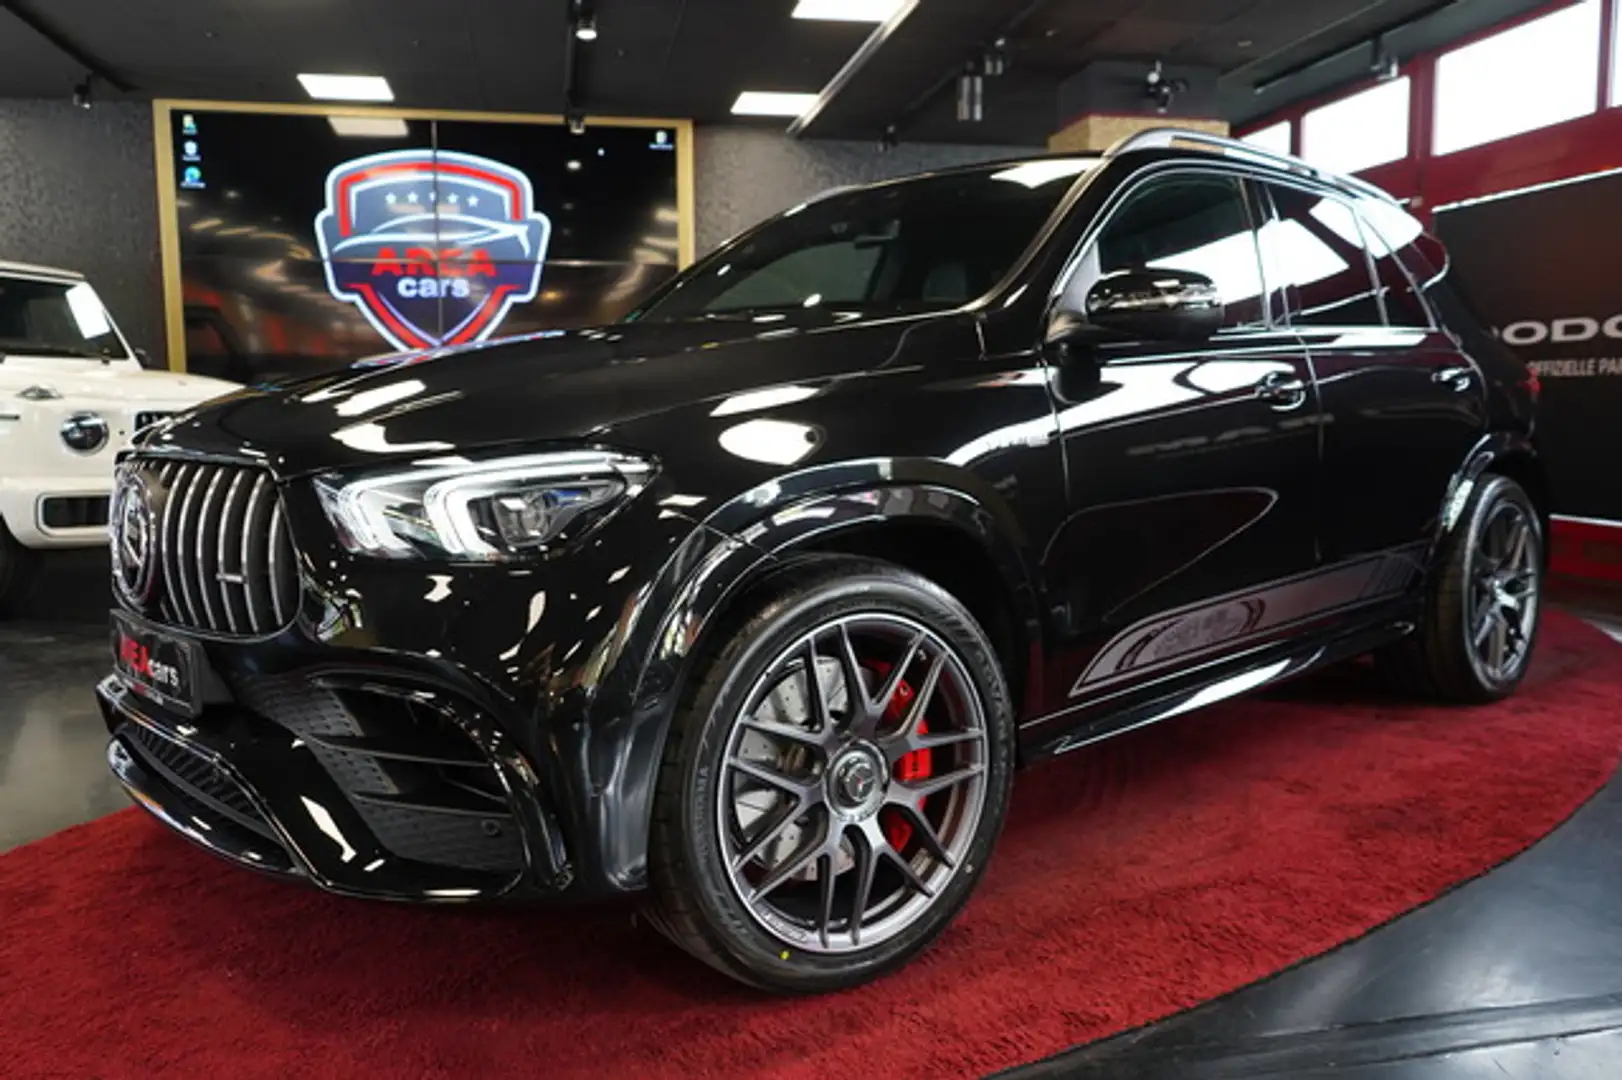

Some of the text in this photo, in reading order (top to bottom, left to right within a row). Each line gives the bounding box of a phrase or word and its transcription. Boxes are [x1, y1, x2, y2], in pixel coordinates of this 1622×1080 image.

[372, 246, 497, 277] AREA
[397, 276, 470, 298] cars
[1492, 314, 1622, 345] OD
